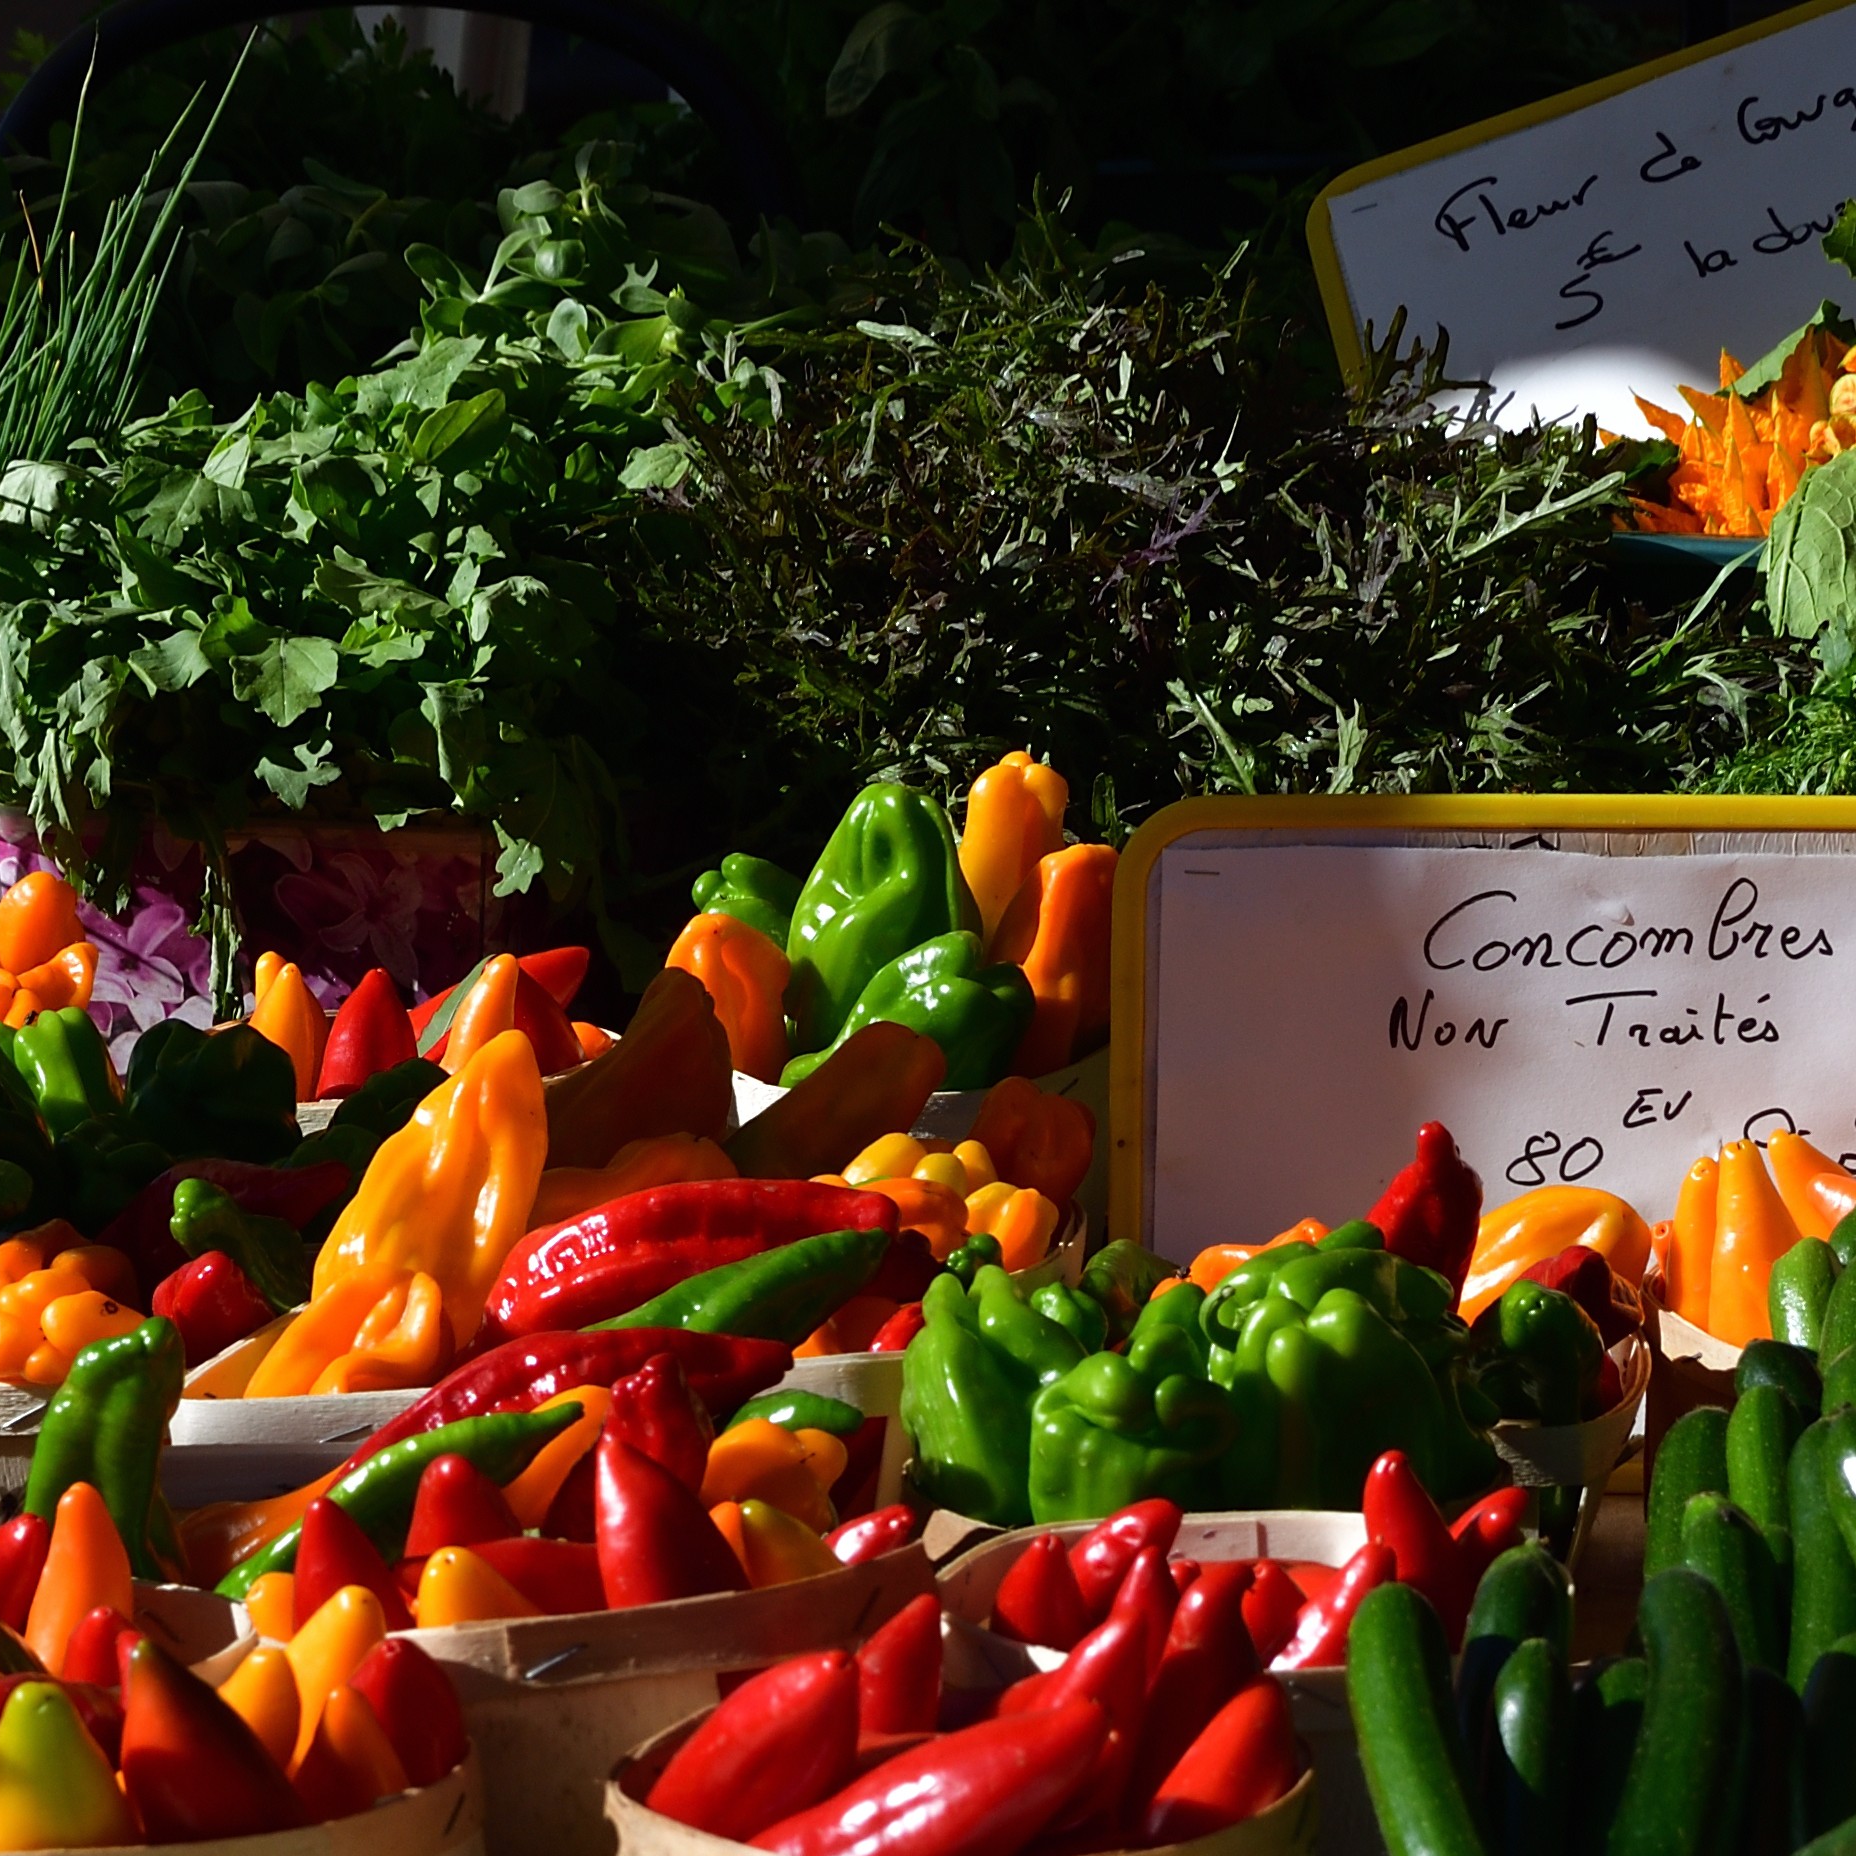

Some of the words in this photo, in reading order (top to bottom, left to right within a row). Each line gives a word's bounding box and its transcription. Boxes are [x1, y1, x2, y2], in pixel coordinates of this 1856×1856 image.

[1434, 174, 1599, 252] Fleur
[1639, 130, 1704, 183] de
[1423, 876, 1835, 972] Concombres
[1564, 989, 1781, 1047] Traités
[1505, 1130, 1605, 1187] 80
